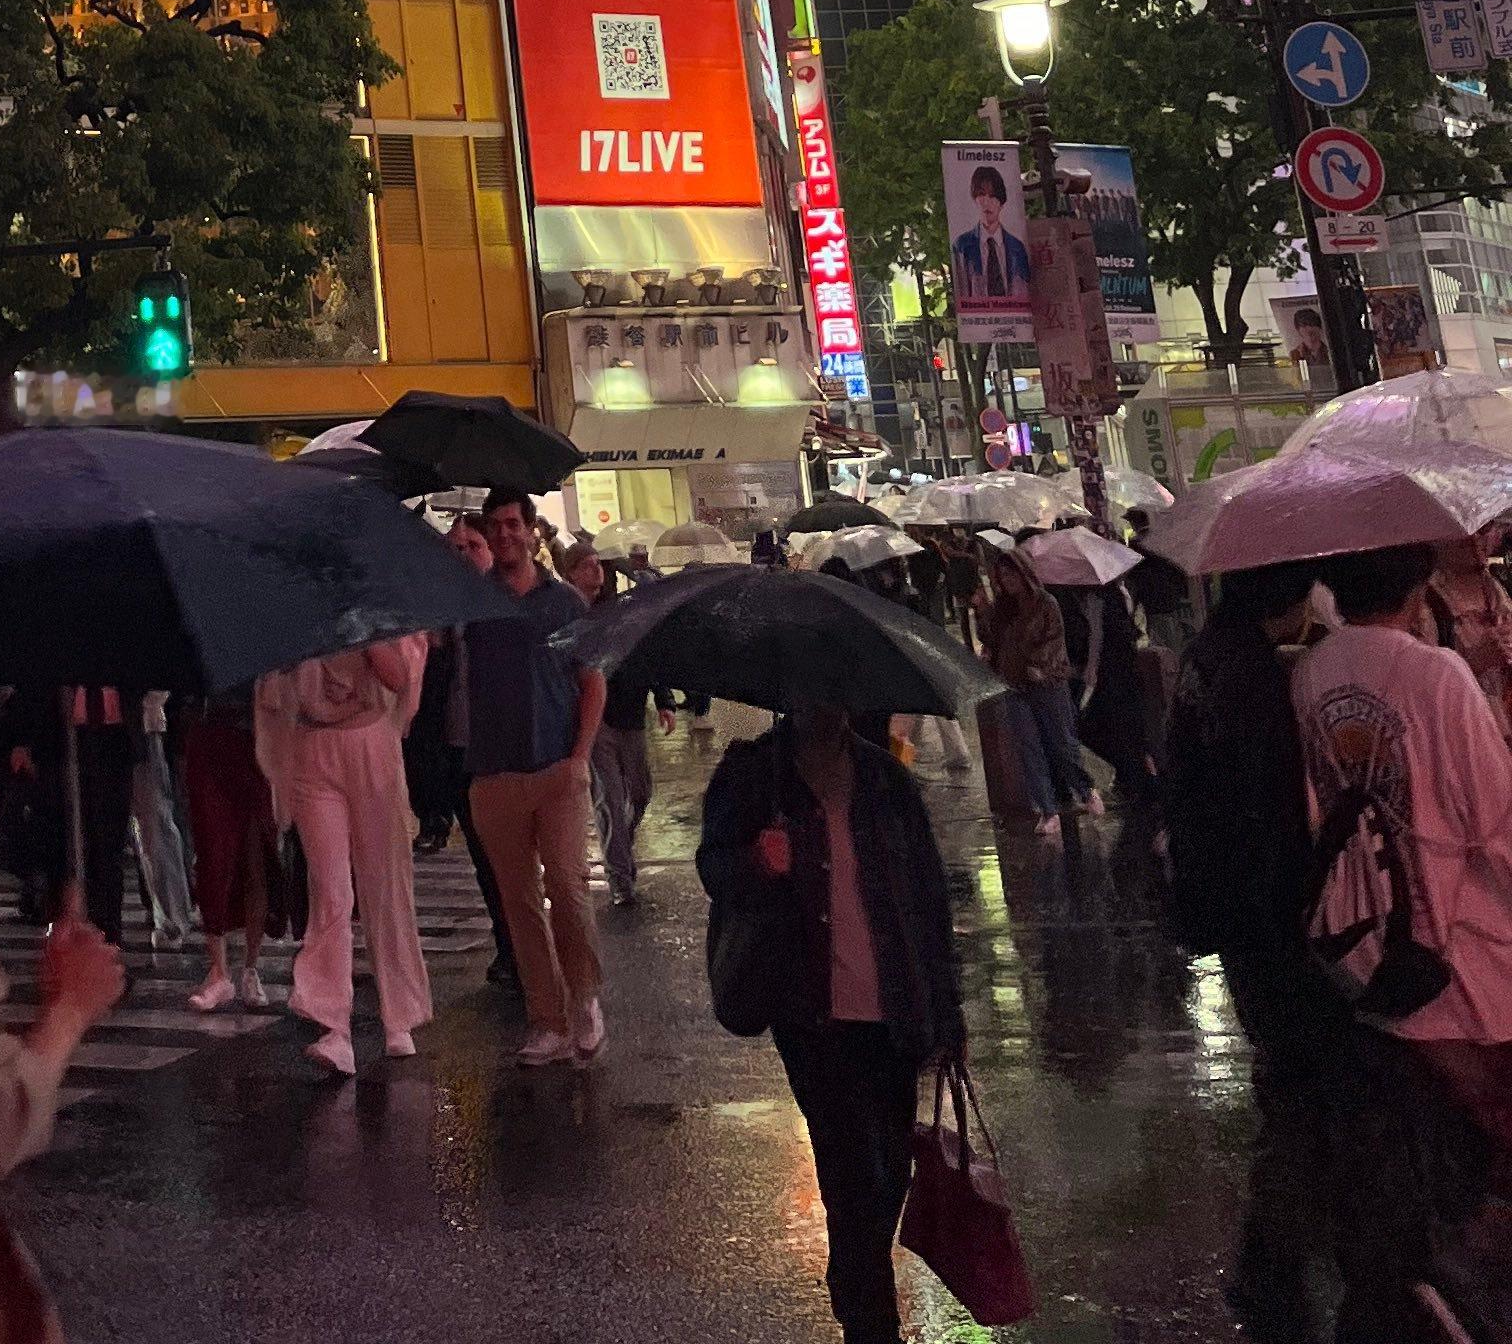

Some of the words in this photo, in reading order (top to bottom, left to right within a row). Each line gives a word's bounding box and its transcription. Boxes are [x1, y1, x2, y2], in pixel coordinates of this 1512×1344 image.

[580, 130, 704, 173] 17LIVE
[803, 118, 831, 178] アコム
[1327, 222, 1337, 234] 8
[1358, 220, 1375, 234] 20
[806, 208, 858, 348] スギ薬局
[586, 320, 789, 348] 渋谷駅前ビル
[646, 448, 705, 461] EKIMAE
[714, 447, 726, 459] A
